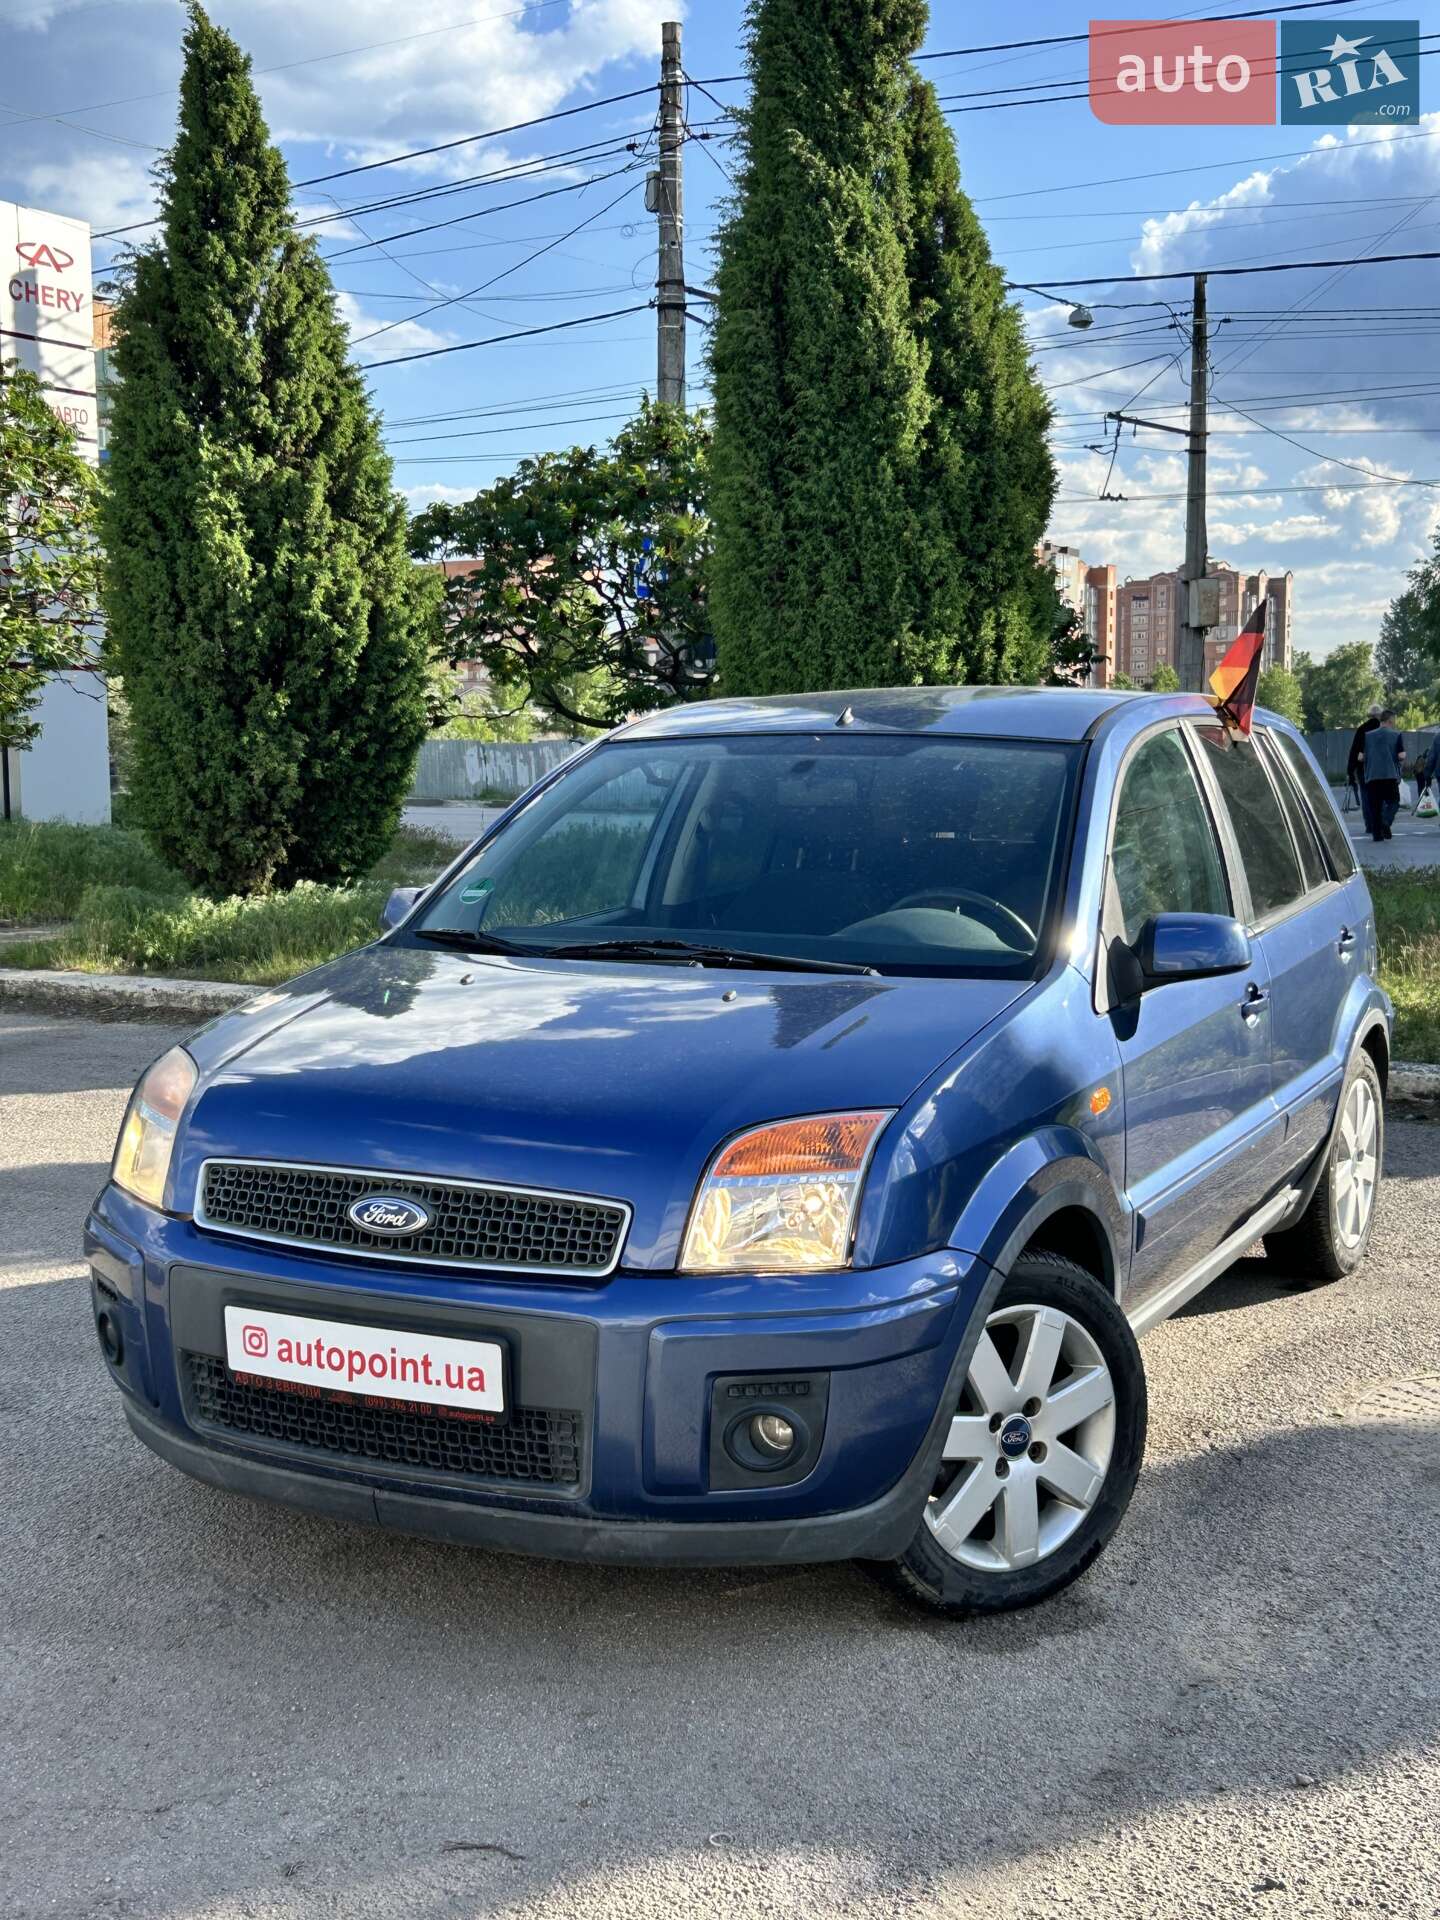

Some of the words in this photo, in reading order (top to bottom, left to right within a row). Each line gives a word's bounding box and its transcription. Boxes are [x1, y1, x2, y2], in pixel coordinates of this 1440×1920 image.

[9, 278, 84, 313] CHERY
[52, 405, 89, 425] АВТО
[363, 1203, 409, 1227] Ford
[277, 1337, 486, 1392] autopoint.ua
[235, 1372, 263, 1389] АВТО
